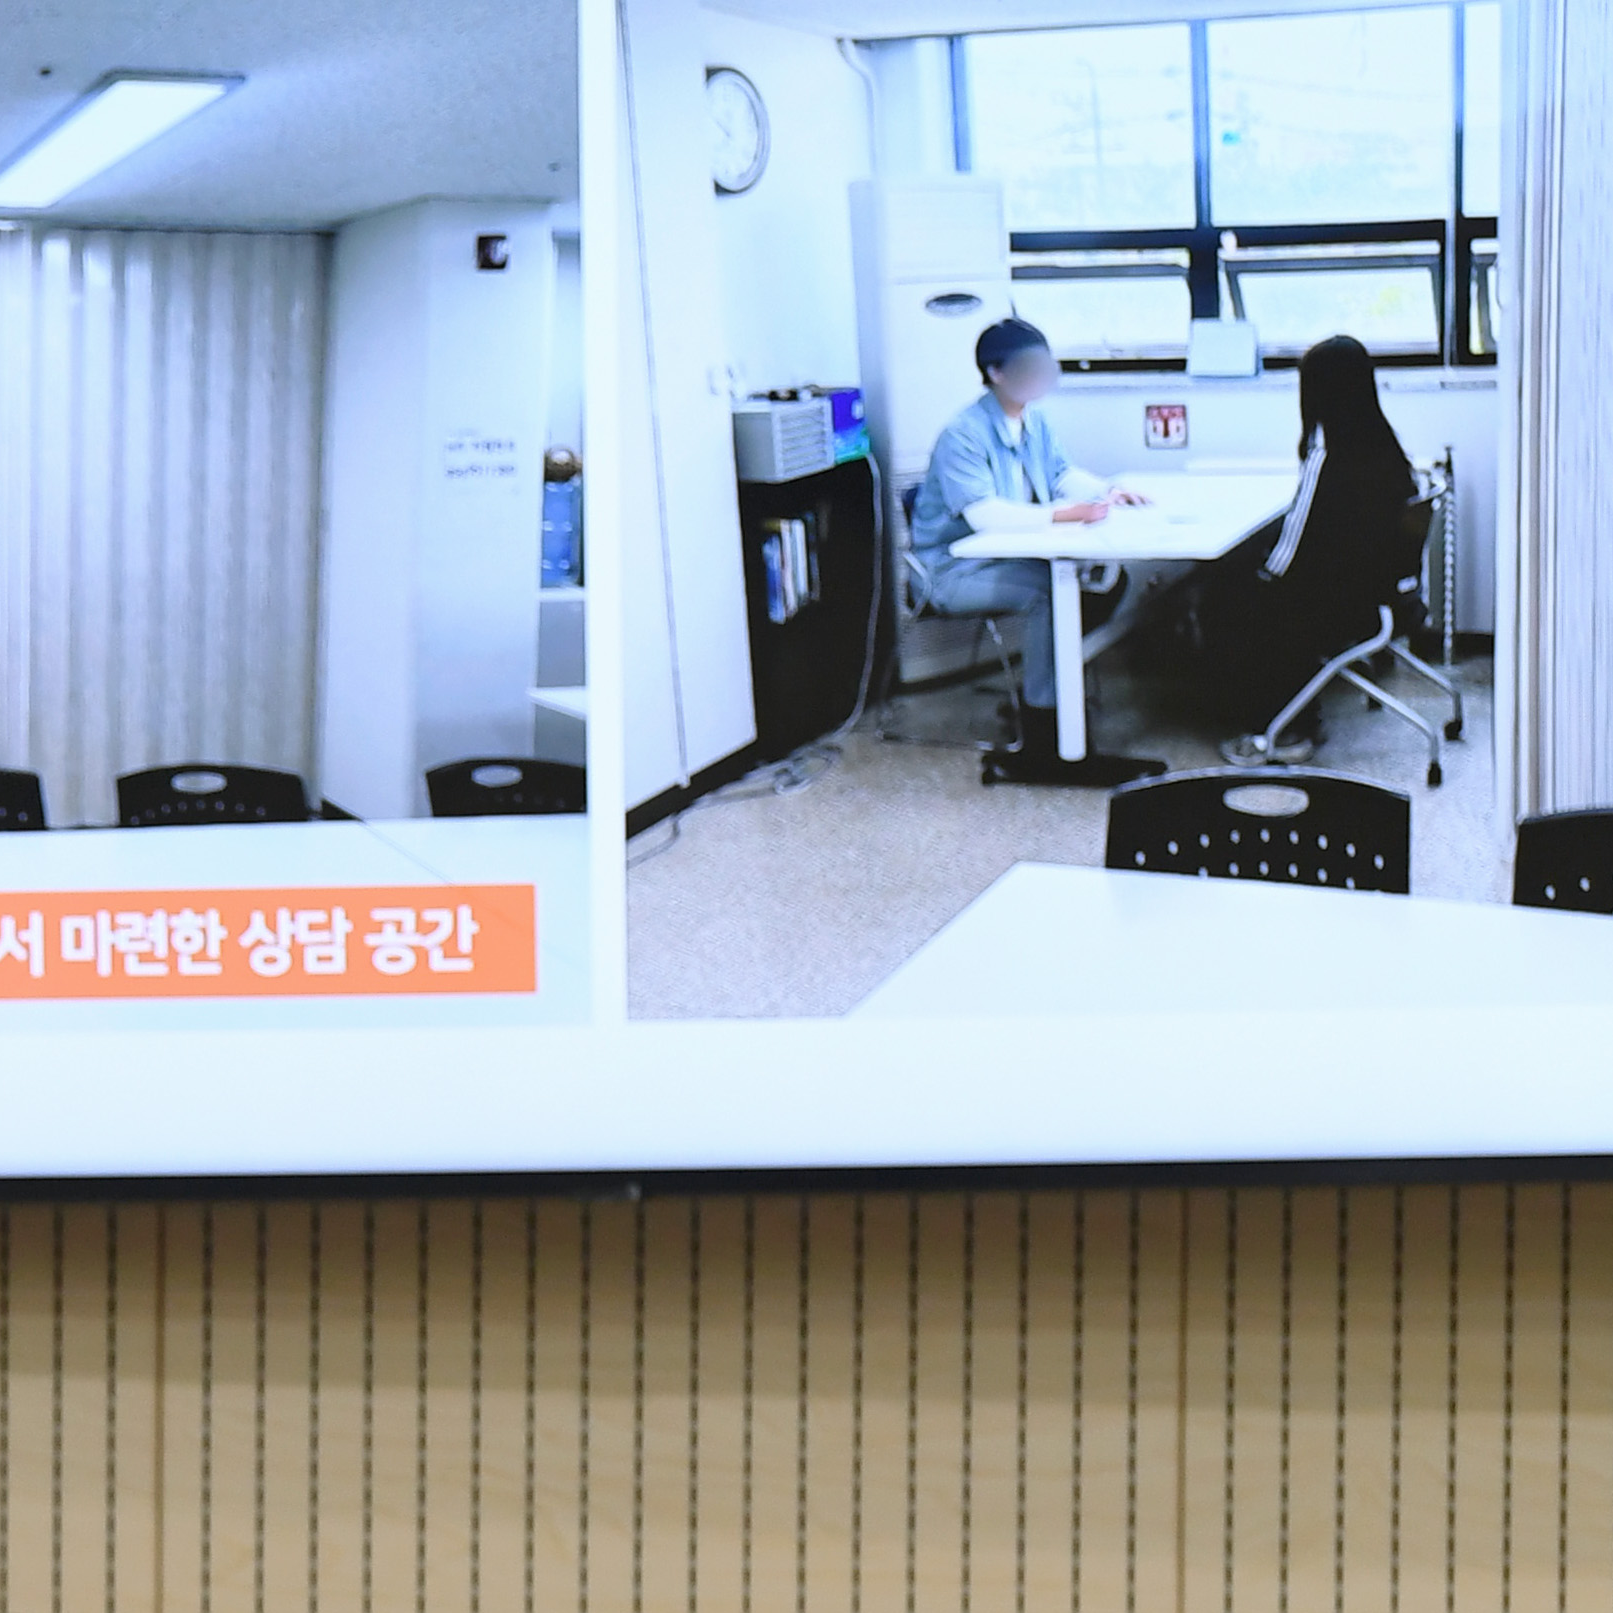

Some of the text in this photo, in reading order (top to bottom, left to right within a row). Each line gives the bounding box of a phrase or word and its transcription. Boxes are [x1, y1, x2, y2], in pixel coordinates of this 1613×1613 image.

[60, 908, 228, 977] 마련한
[238, 906, 354, 977] 상담
[363, 904, 480, 975] 공간
